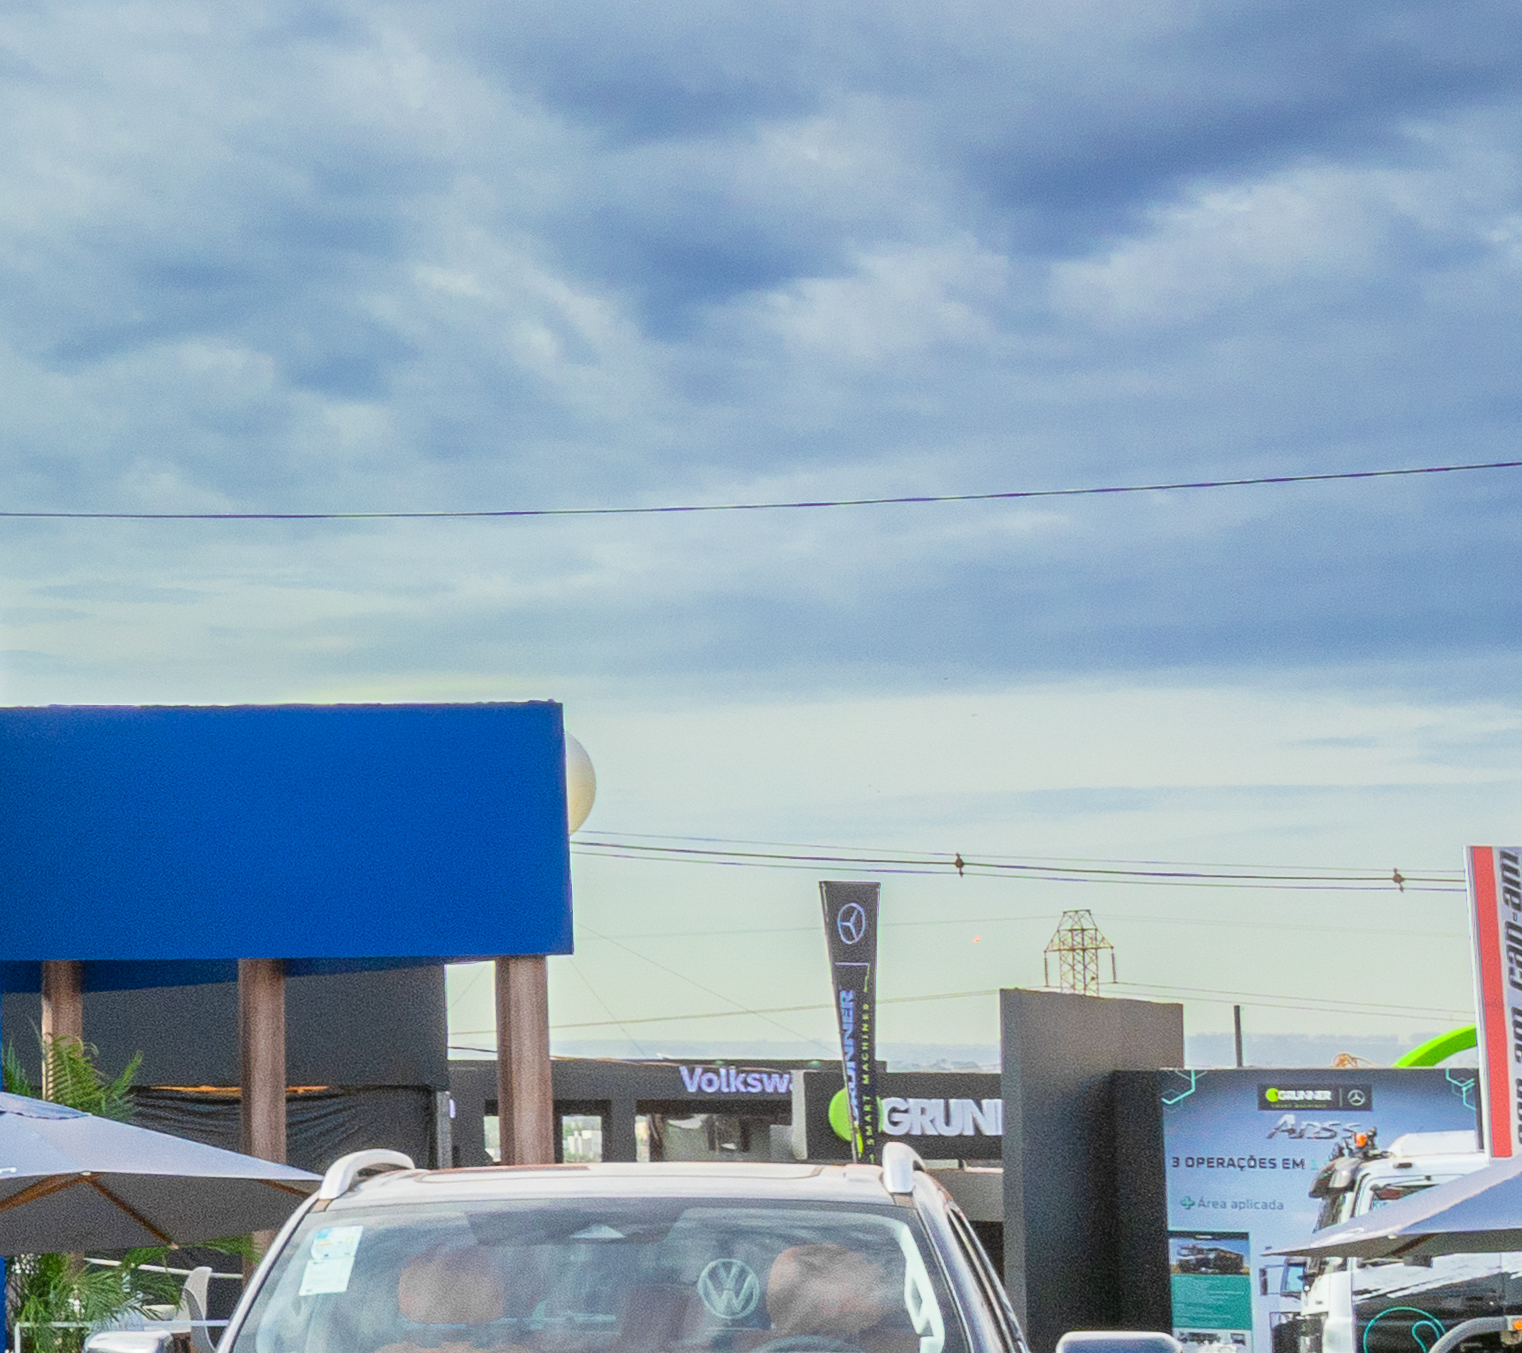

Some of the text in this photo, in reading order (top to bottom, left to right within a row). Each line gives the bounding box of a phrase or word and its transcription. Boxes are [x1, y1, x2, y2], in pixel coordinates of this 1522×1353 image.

[678, 1065, 793, 1093] Volksw
[881, 1097, 1003, 1137] GRUN
[1171, 1156, 1180, 1168] 3
[1185, 1154, 1277, 1171] OPERAÇÕES
[1281, 1157, 1306, 1170] EM
[1197, 1196, 1284, 1211] Área aplicada
